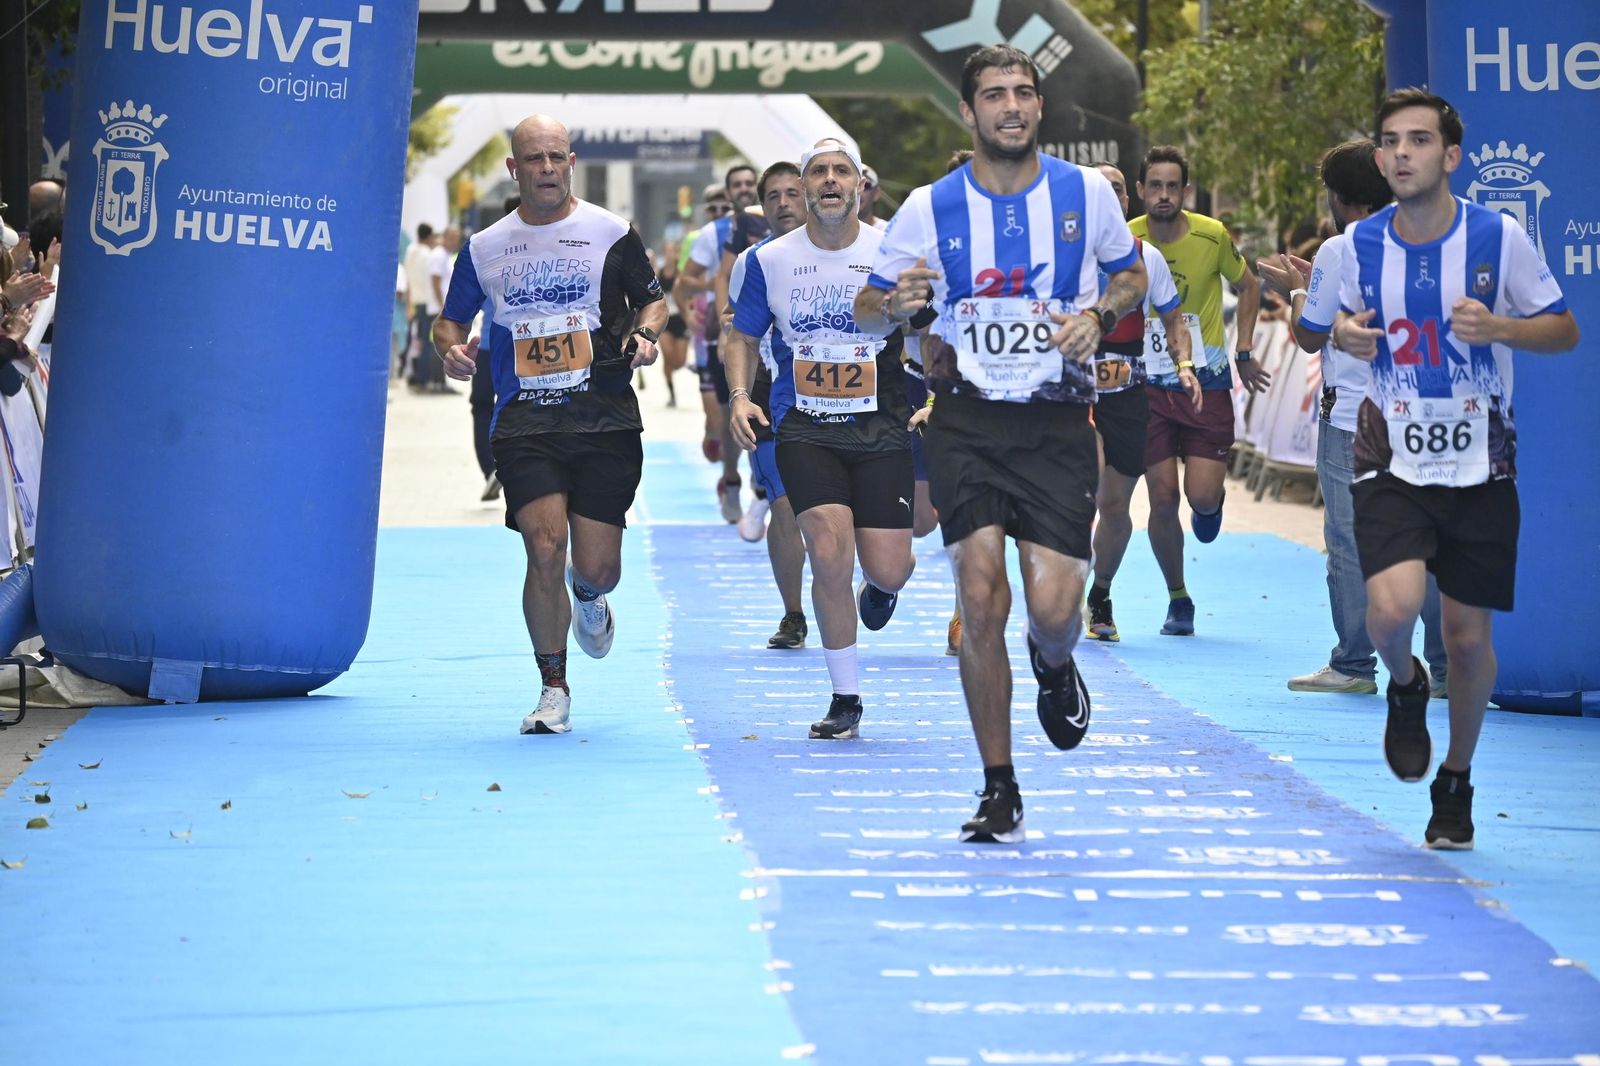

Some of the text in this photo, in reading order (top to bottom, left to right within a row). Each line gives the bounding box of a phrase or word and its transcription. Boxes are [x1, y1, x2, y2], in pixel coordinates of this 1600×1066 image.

[104, 0, 354, 68] Huelva
[258, 73, 348, 102] original
[96, 190, 105, 222] PORTUS
[142, 175, 151, 214] CUSTODIA
[178, 184, 337, 212] Ayuntamiento de
[174, 209, 333, 251] HUELVA
[501, 258, 592, 279] RUNNERS
[1564, 244, 1600, 275] H
[504, 264, 589, 296] la Palmera
[526, 333, 576, 365] 451
[963, 323, 1053, 355] 1029
[1151, 333, 1169, 353] 8
[537, 373, 572, 385] Huelva
[805, 363, 863, 389] 412
[985, 368, 1029, 381] Huelva
[518, 390, 545, 401] BAR
[815, 399, 851, 408] Huelva
[1404, 421, 1472, 455] 686
